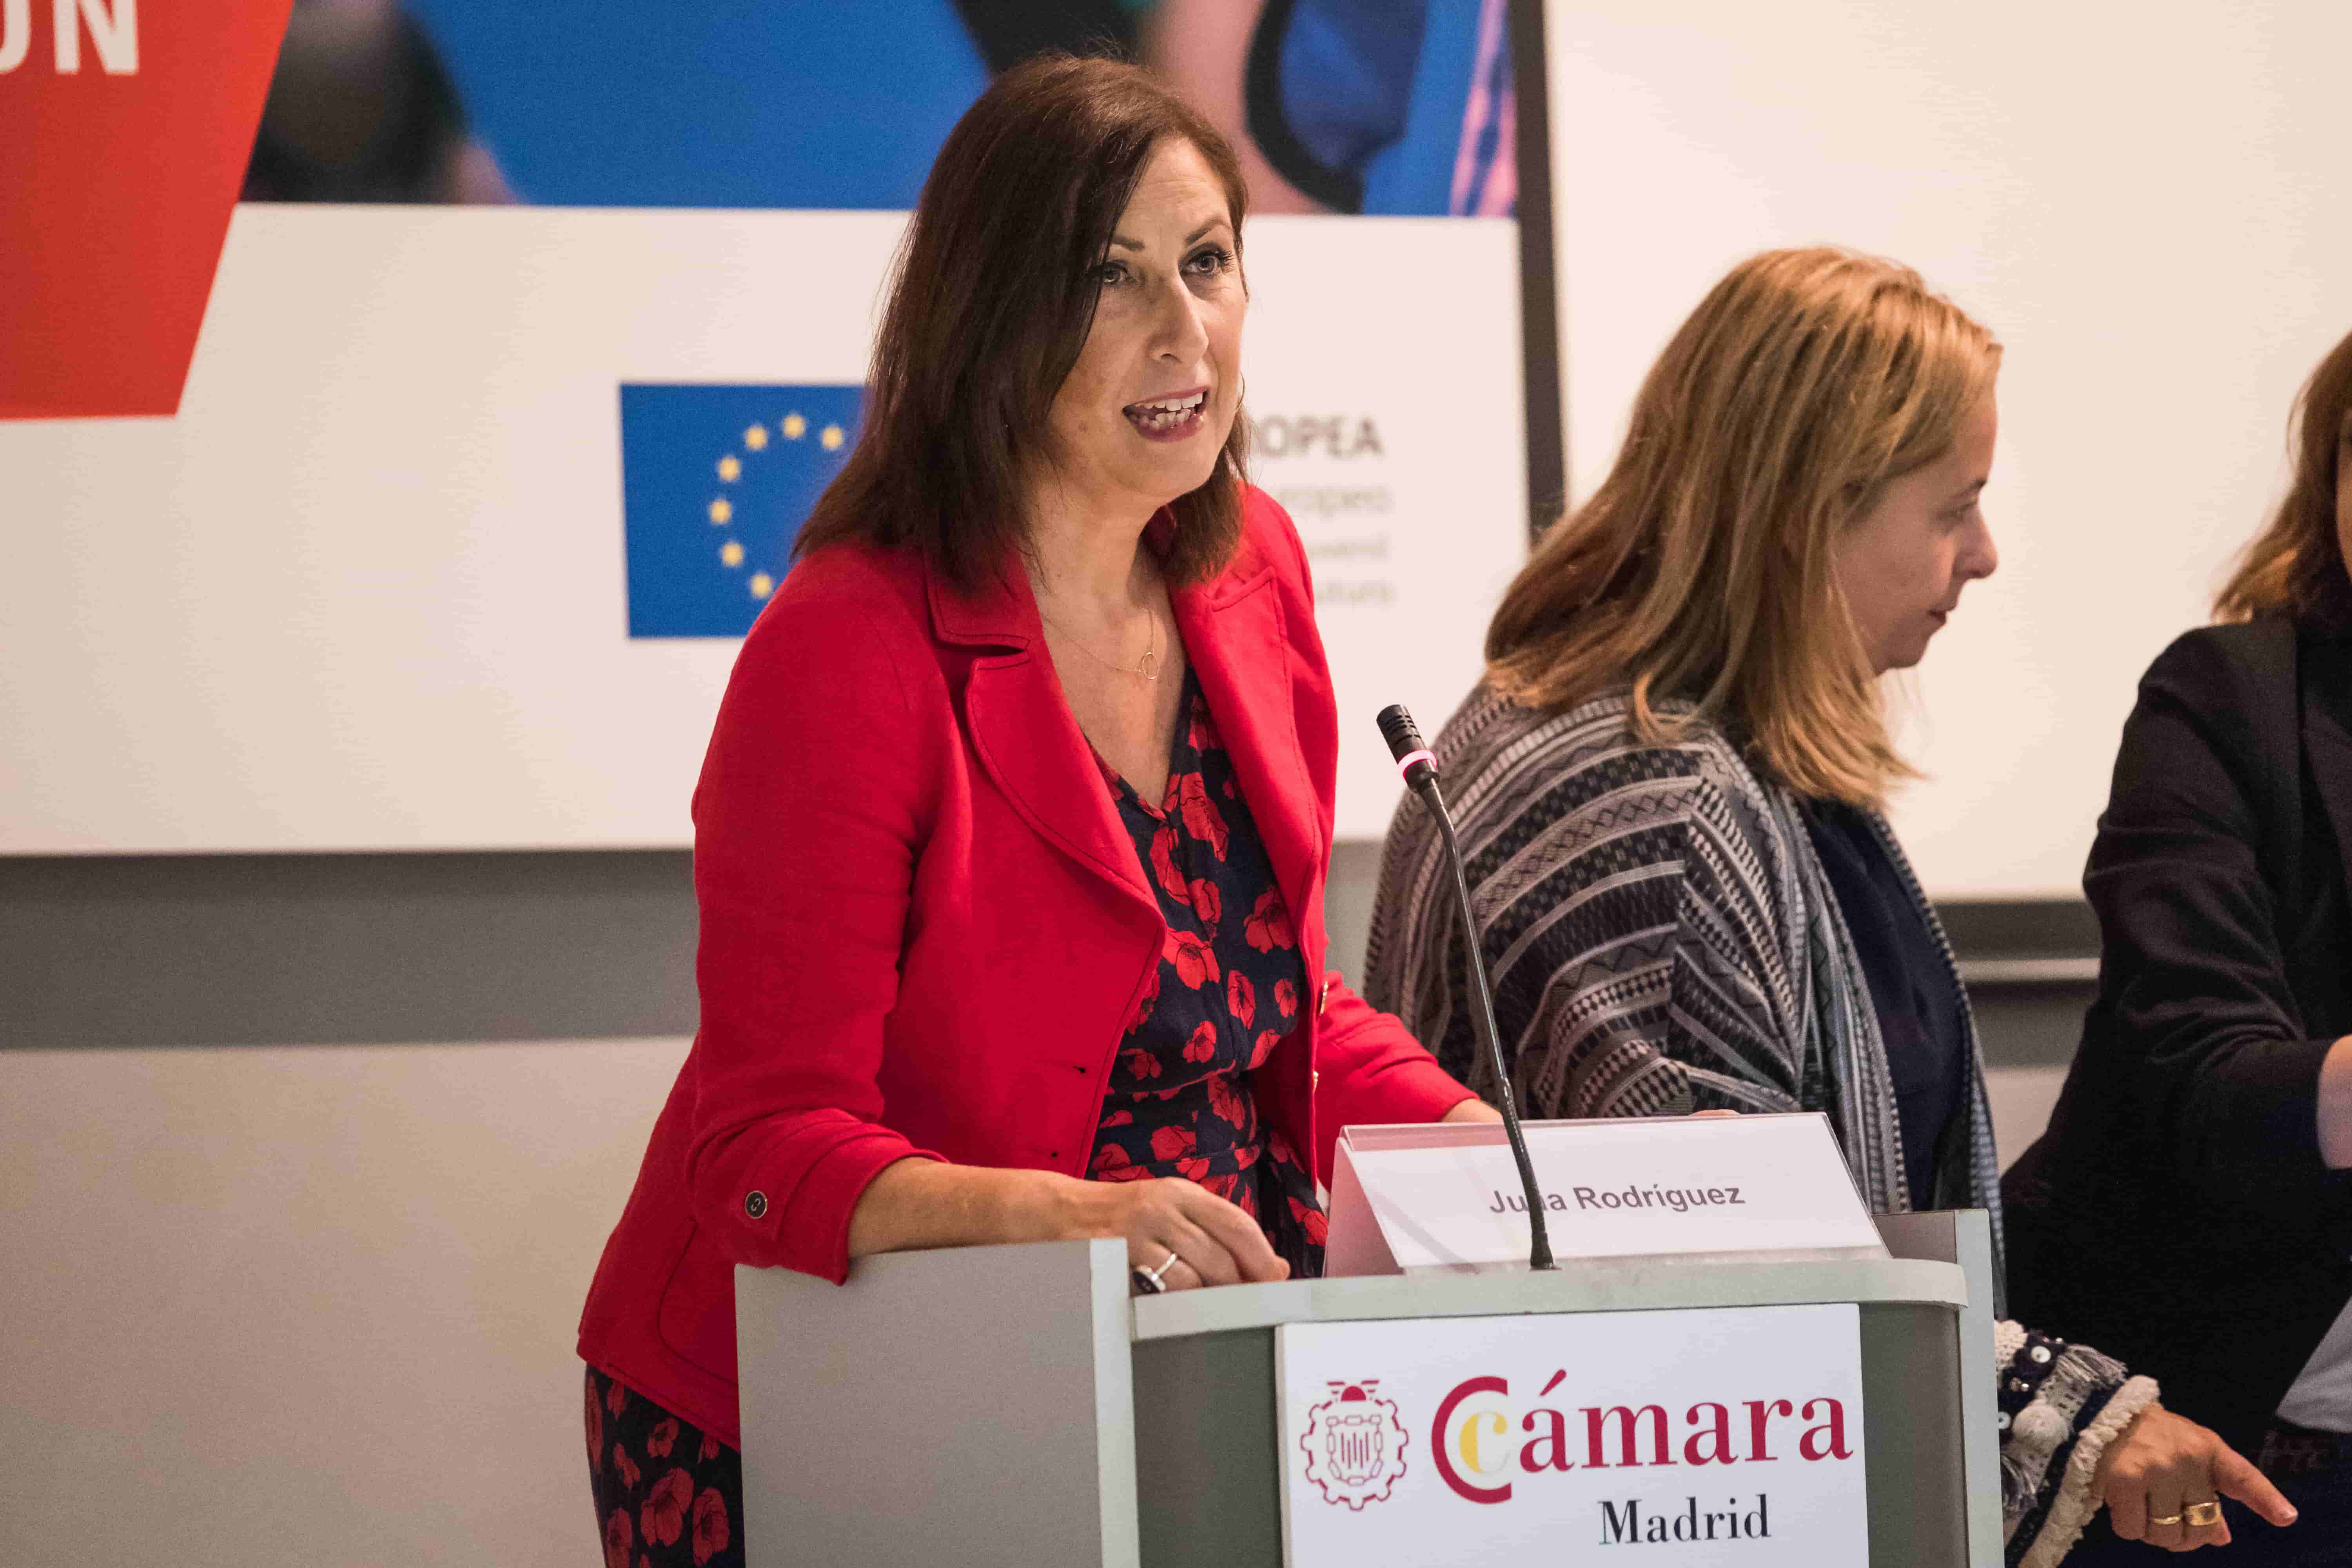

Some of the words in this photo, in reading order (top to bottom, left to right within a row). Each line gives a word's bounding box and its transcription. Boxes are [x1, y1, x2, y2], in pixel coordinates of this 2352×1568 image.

[1252, 416, 1385, 458] OPEA
[1573, 1184, 1746, 1212] Rodríguez
[1598, 1494, 1771, 1545] Madrid
